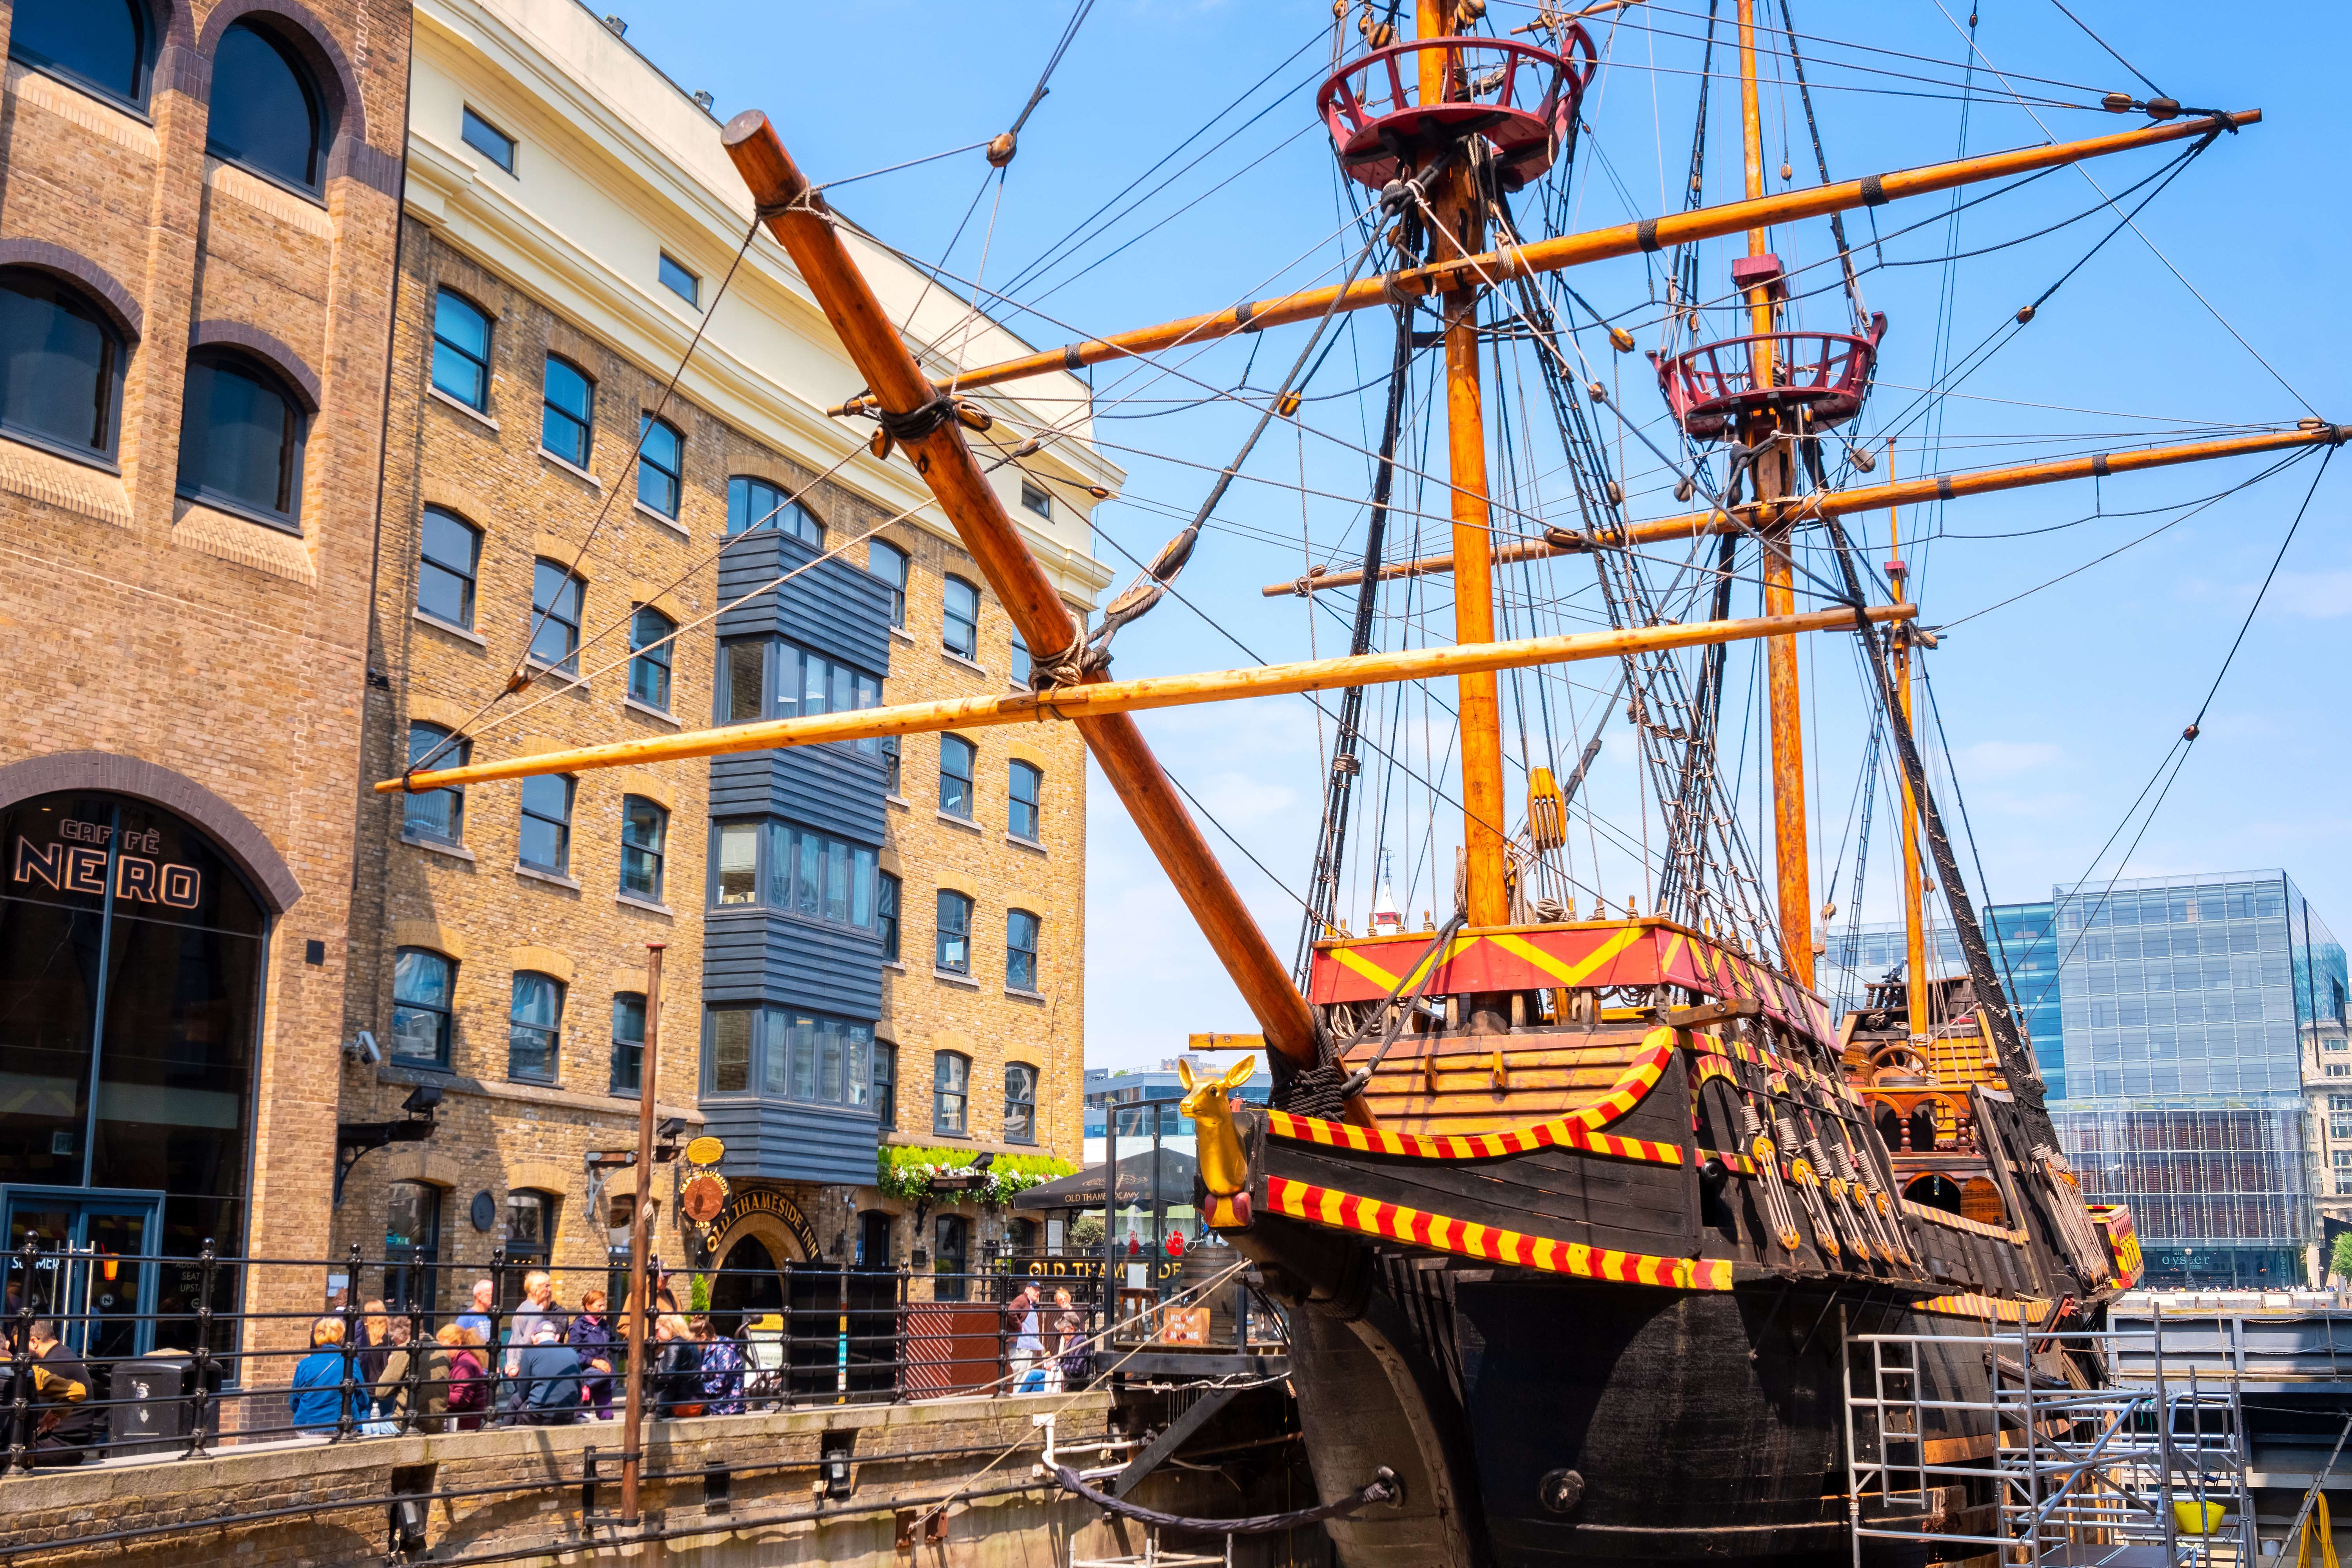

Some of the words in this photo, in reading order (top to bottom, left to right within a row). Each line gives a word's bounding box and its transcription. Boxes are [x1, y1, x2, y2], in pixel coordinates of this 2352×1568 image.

[13, 835, 201, 909] NERO
[1065, 1194, 1080, 1202] OLD
[707, 1216, 730, 1252] OLD
[732, 1192, 803, 1230] THAMESIDE
[802, 1225, 818, 1259] INN
[12, 1256, 60, 1269] SUMER
